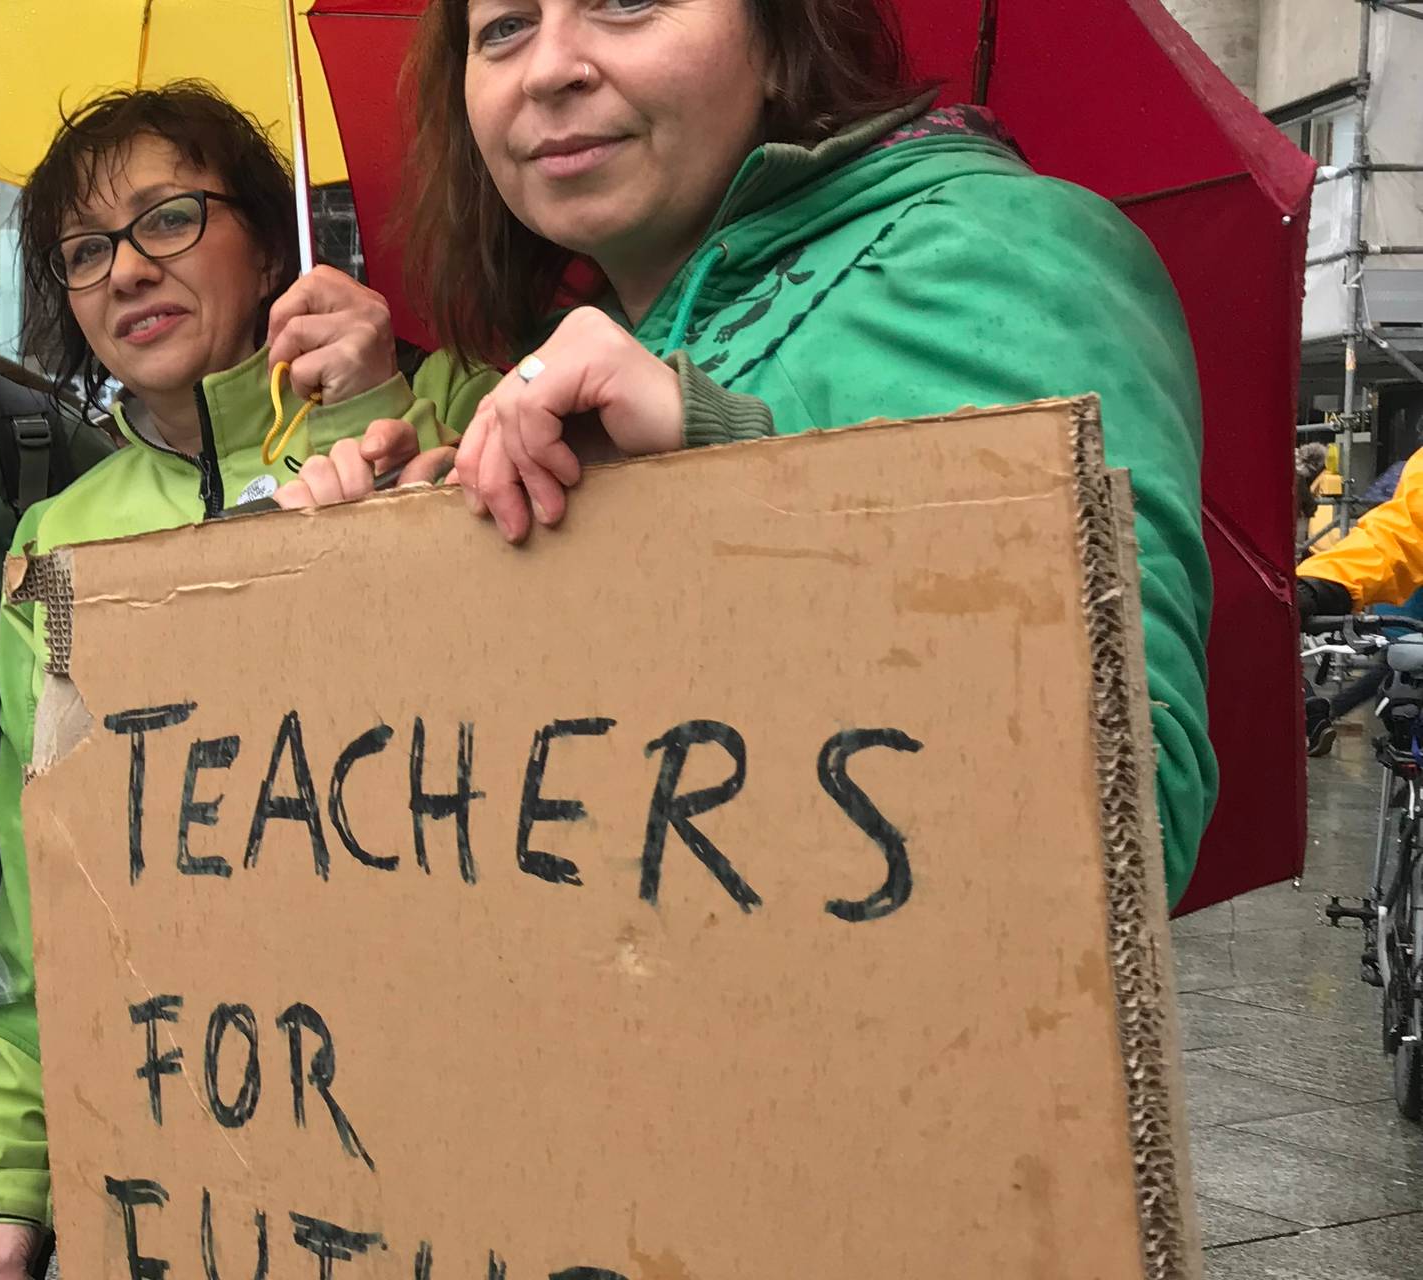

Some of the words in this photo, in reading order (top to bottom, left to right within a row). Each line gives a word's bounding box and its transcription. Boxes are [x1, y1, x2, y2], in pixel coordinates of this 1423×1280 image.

[103, 701, 924, 923] TEACHERS
[129, 994, 377, 1172] FOR
[105, 1174, 631, 1280] FUT
